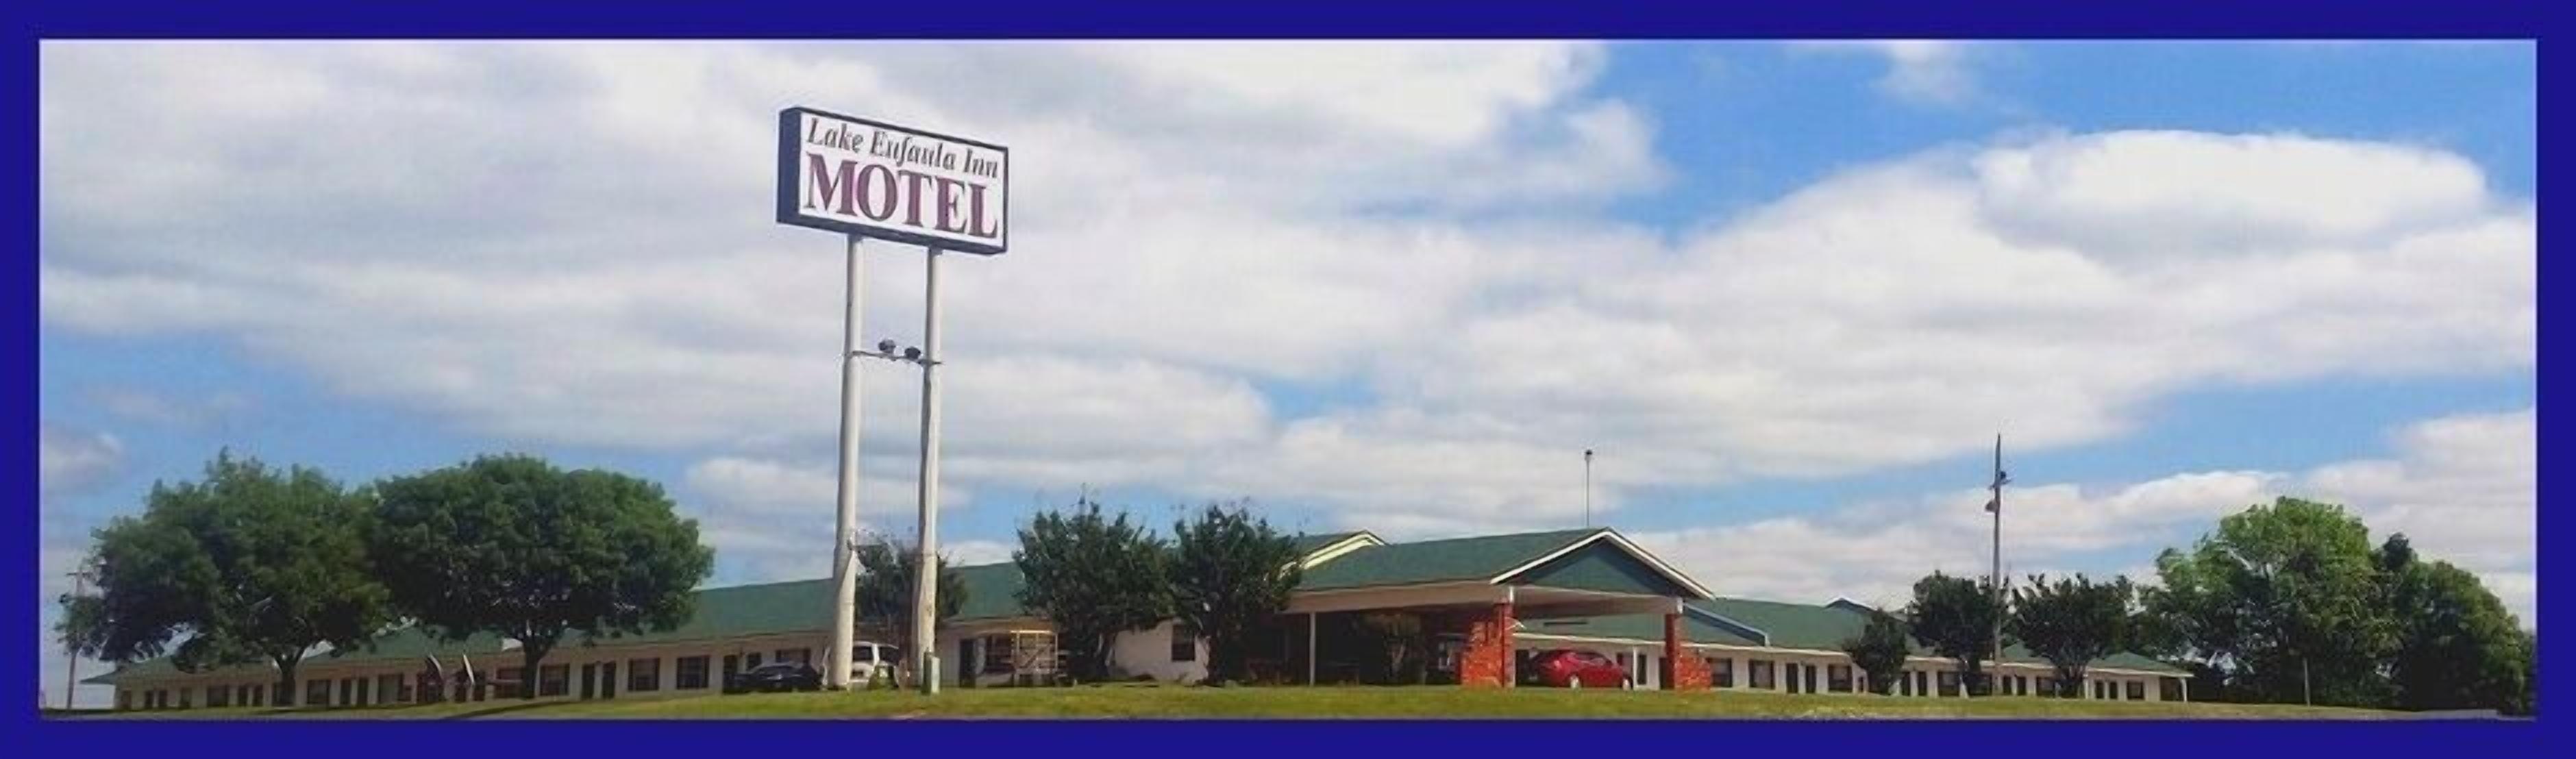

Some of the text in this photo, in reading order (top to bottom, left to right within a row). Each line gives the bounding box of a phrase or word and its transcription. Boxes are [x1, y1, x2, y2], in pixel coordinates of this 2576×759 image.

[806, 117, 998, 178] Lake Eufaula Inn
[804, 151, 998, 238] MOTEL
